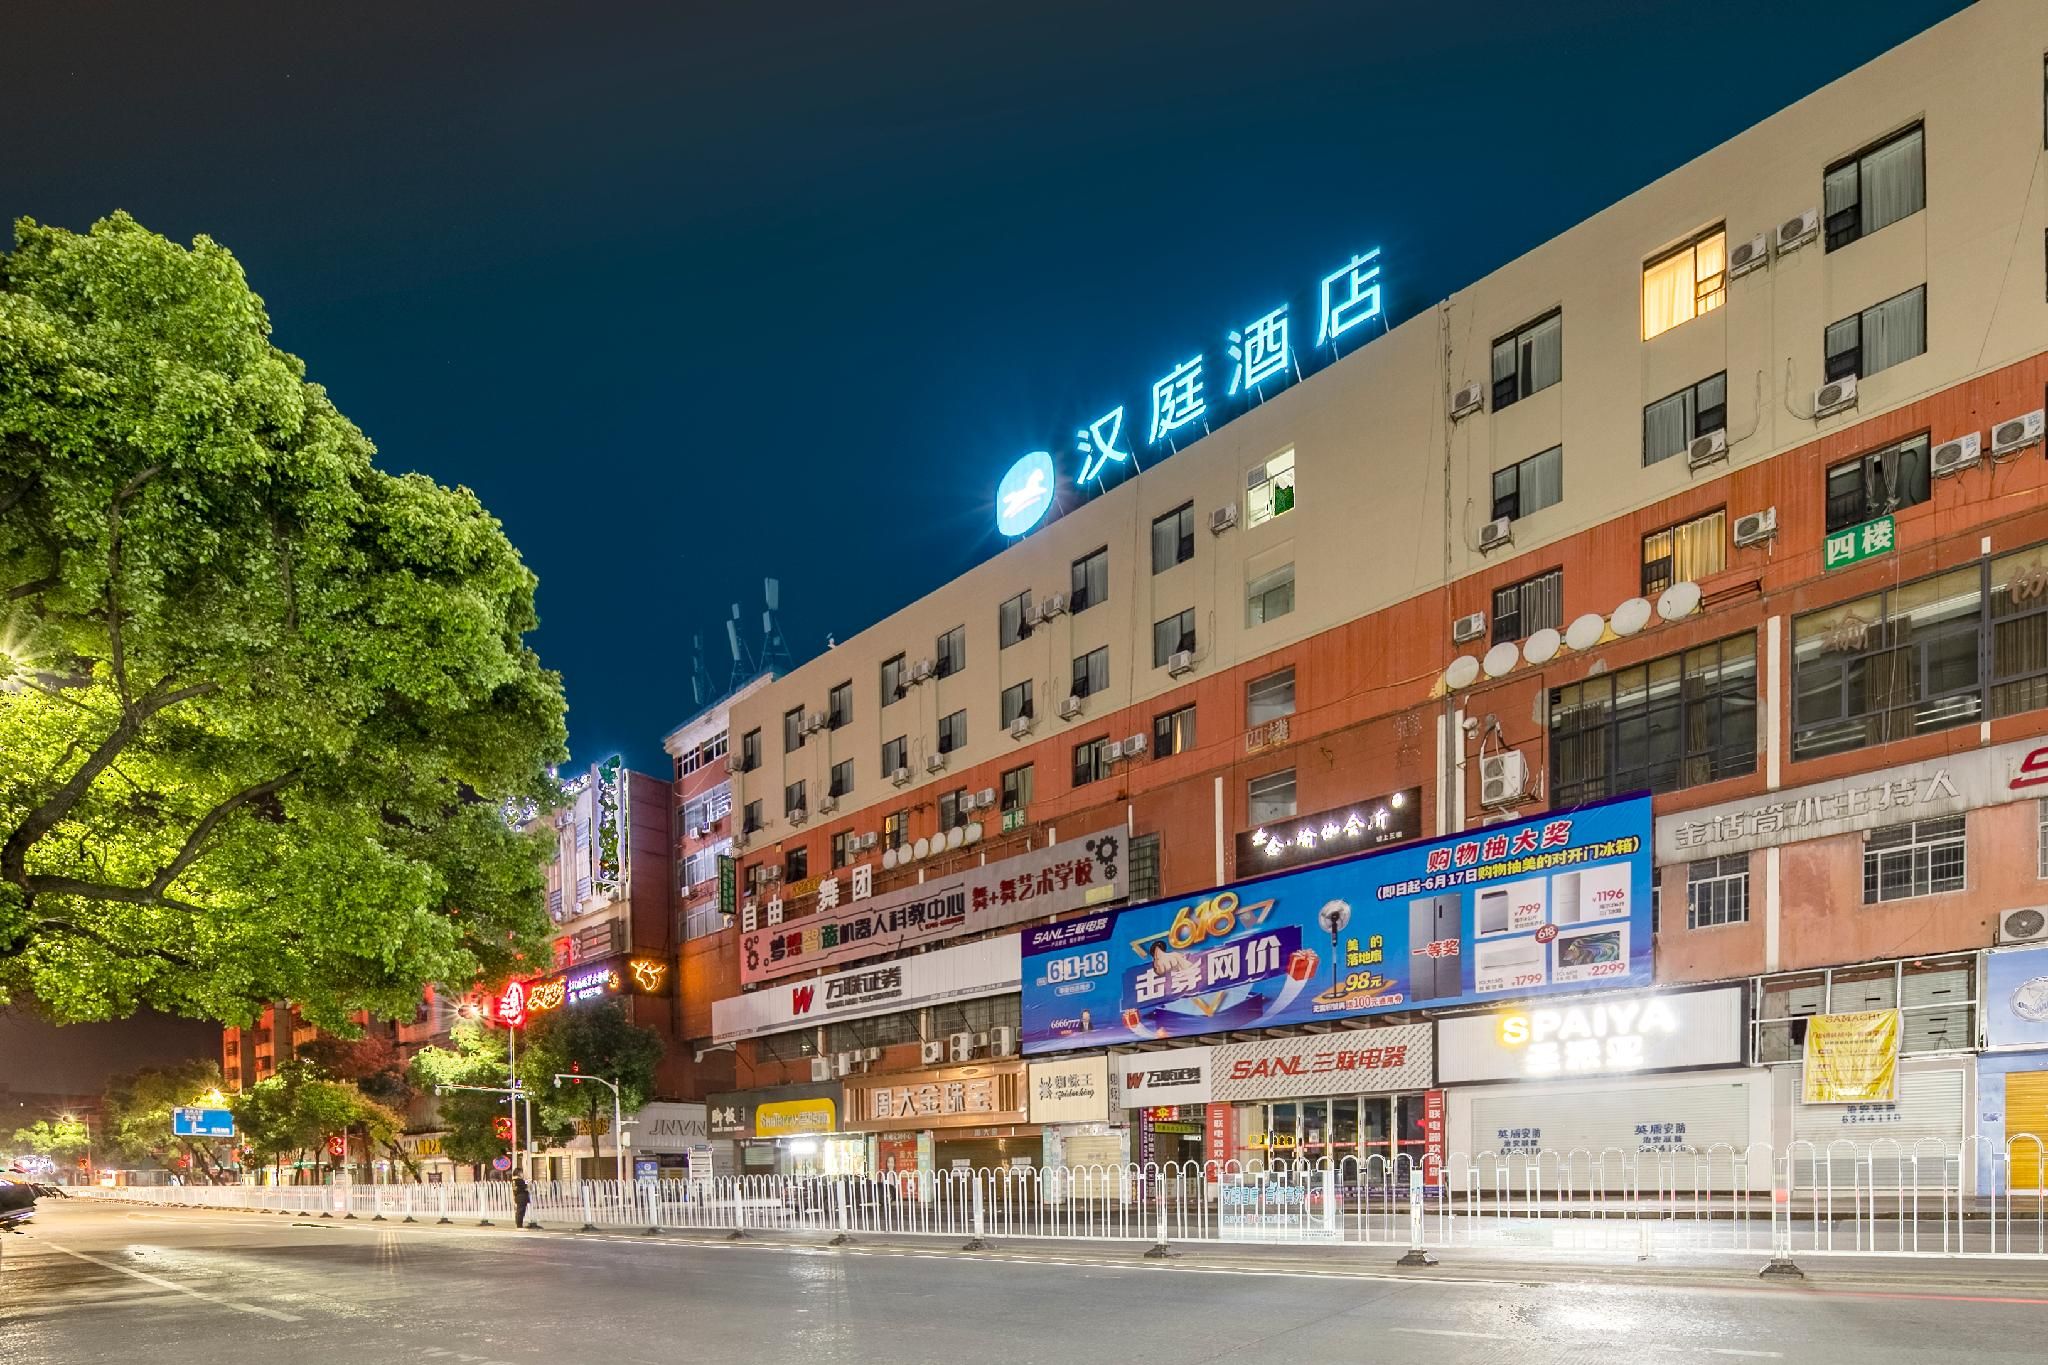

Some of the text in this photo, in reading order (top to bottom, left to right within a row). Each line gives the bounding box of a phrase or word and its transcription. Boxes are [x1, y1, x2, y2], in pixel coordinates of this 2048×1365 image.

[1077, 247, 1381, 485] 汉庭酒店
[1827, 521, 1893, 566] 四楼
[1246, 718, 1290, 752] 四楼
[1676, 769, 1960, 849] 金话筒小主持人
[1427, 820, 1572, 872] 购物抽大奖
[1033, 928, 1063, 945] SANL
[1169, 892, 1238, 949] 618
[1347, 936, 1383, 952] 美的
[1347, 949, 1382, 967] 落地扇
[1411, 938, 1460, 959] 一等奖
[825, 965, 902, 1000] 万联证券
[1345, 970, 1383, 992] 98元
[1230, 1045, 1408, 1080] SANL 三联电器
